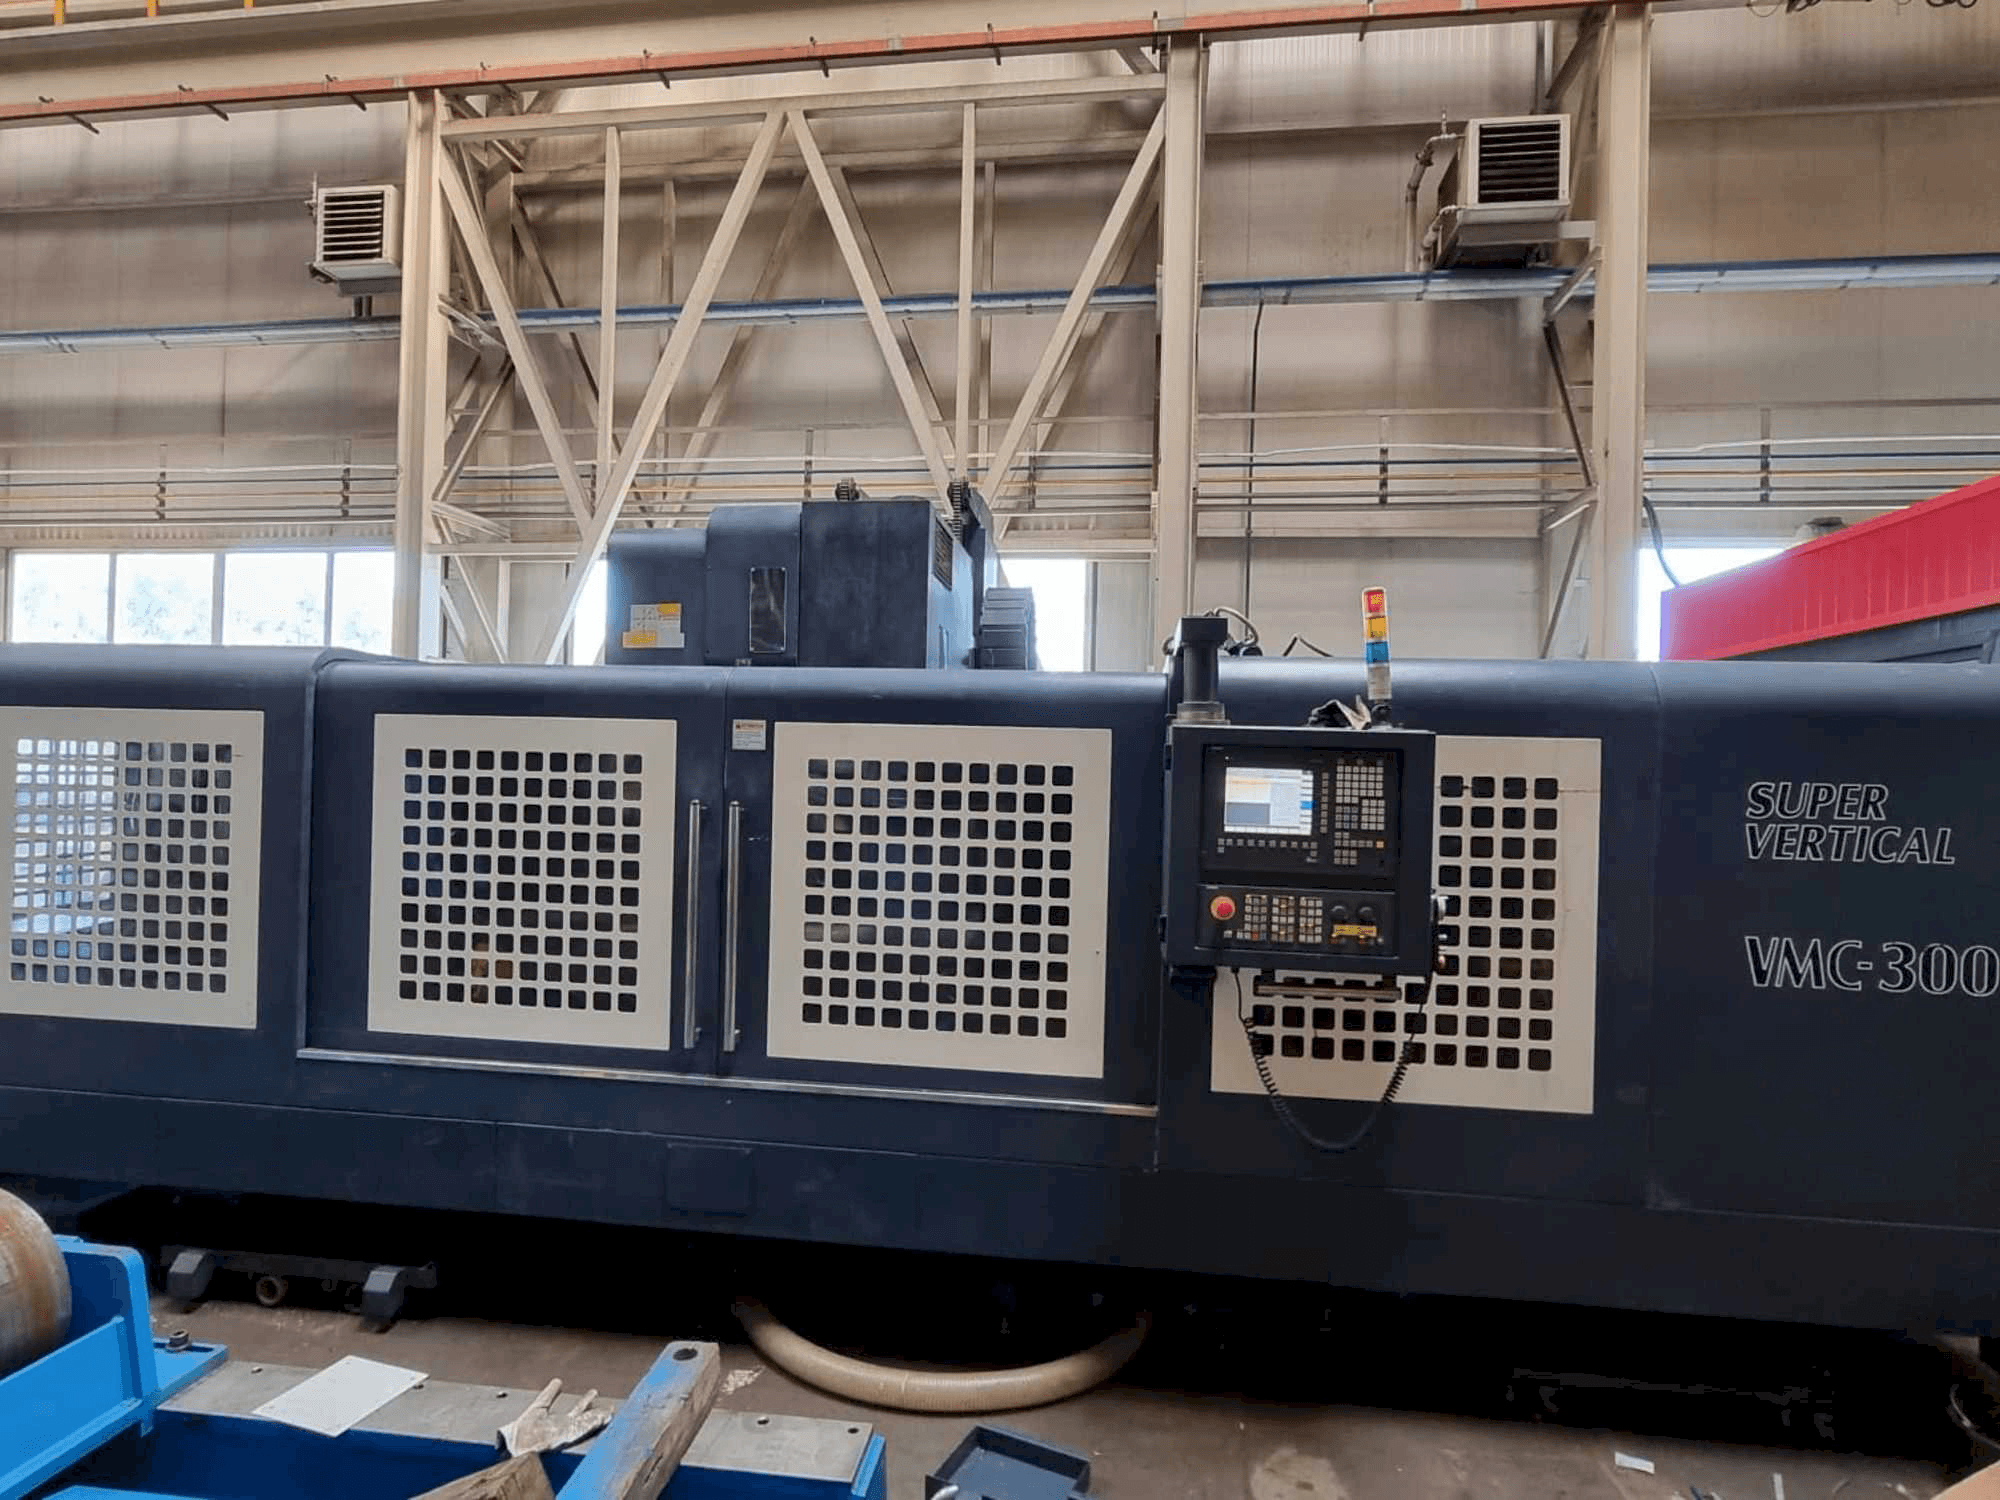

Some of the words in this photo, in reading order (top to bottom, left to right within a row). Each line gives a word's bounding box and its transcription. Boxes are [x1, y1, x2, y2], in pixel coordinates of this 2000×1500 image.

[1746, 781, 1888, 820] SUPER
[1745, 824, 1955, 864] VERTICAL
[1744, 936, 2000, 997] VMC-300
